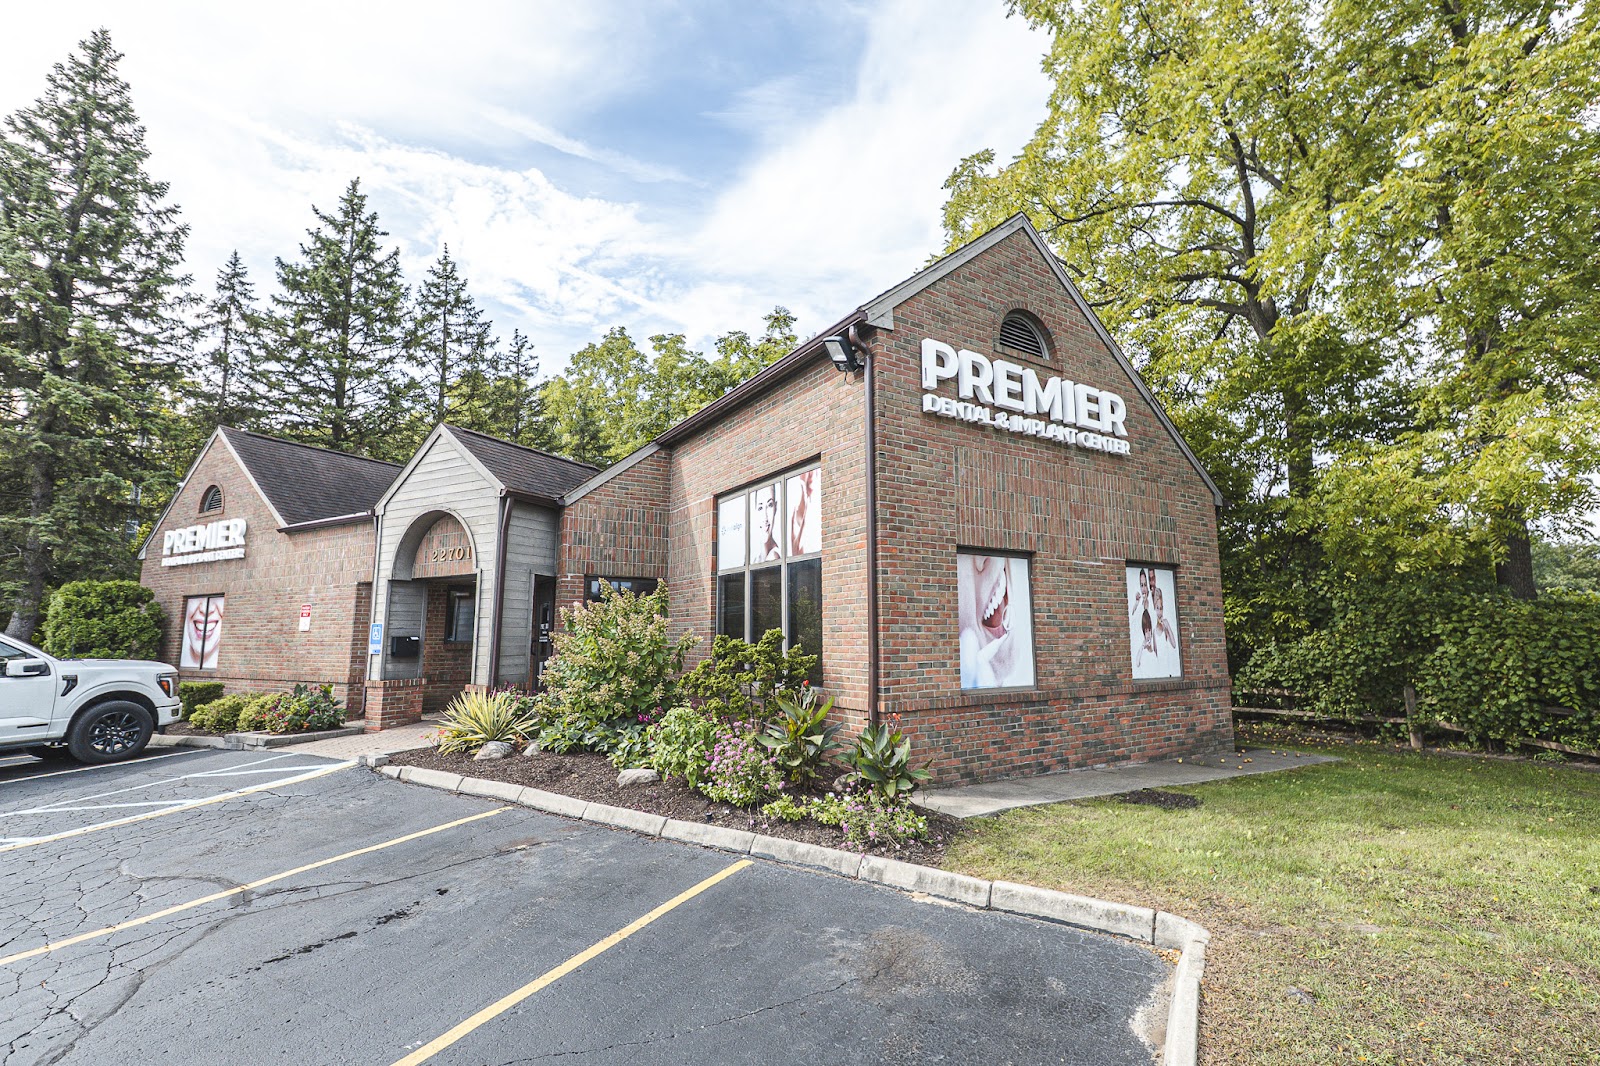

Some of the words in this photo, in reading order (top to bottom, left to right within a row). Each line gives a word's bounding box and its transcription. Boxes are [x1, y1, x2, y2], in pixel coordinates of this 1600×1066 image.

[921, 337, 1128, 436] PREMIER
[923, 393, 995, 424] DENTAL
[994, 411, 1010, 430] &
[1009, 414, 1078, 445] IMPLANT
[1077, 431, 1131, 455] CENTER
[162, 518, 247, 555] PREMIER
[432, 546, 472, 562] 22701
